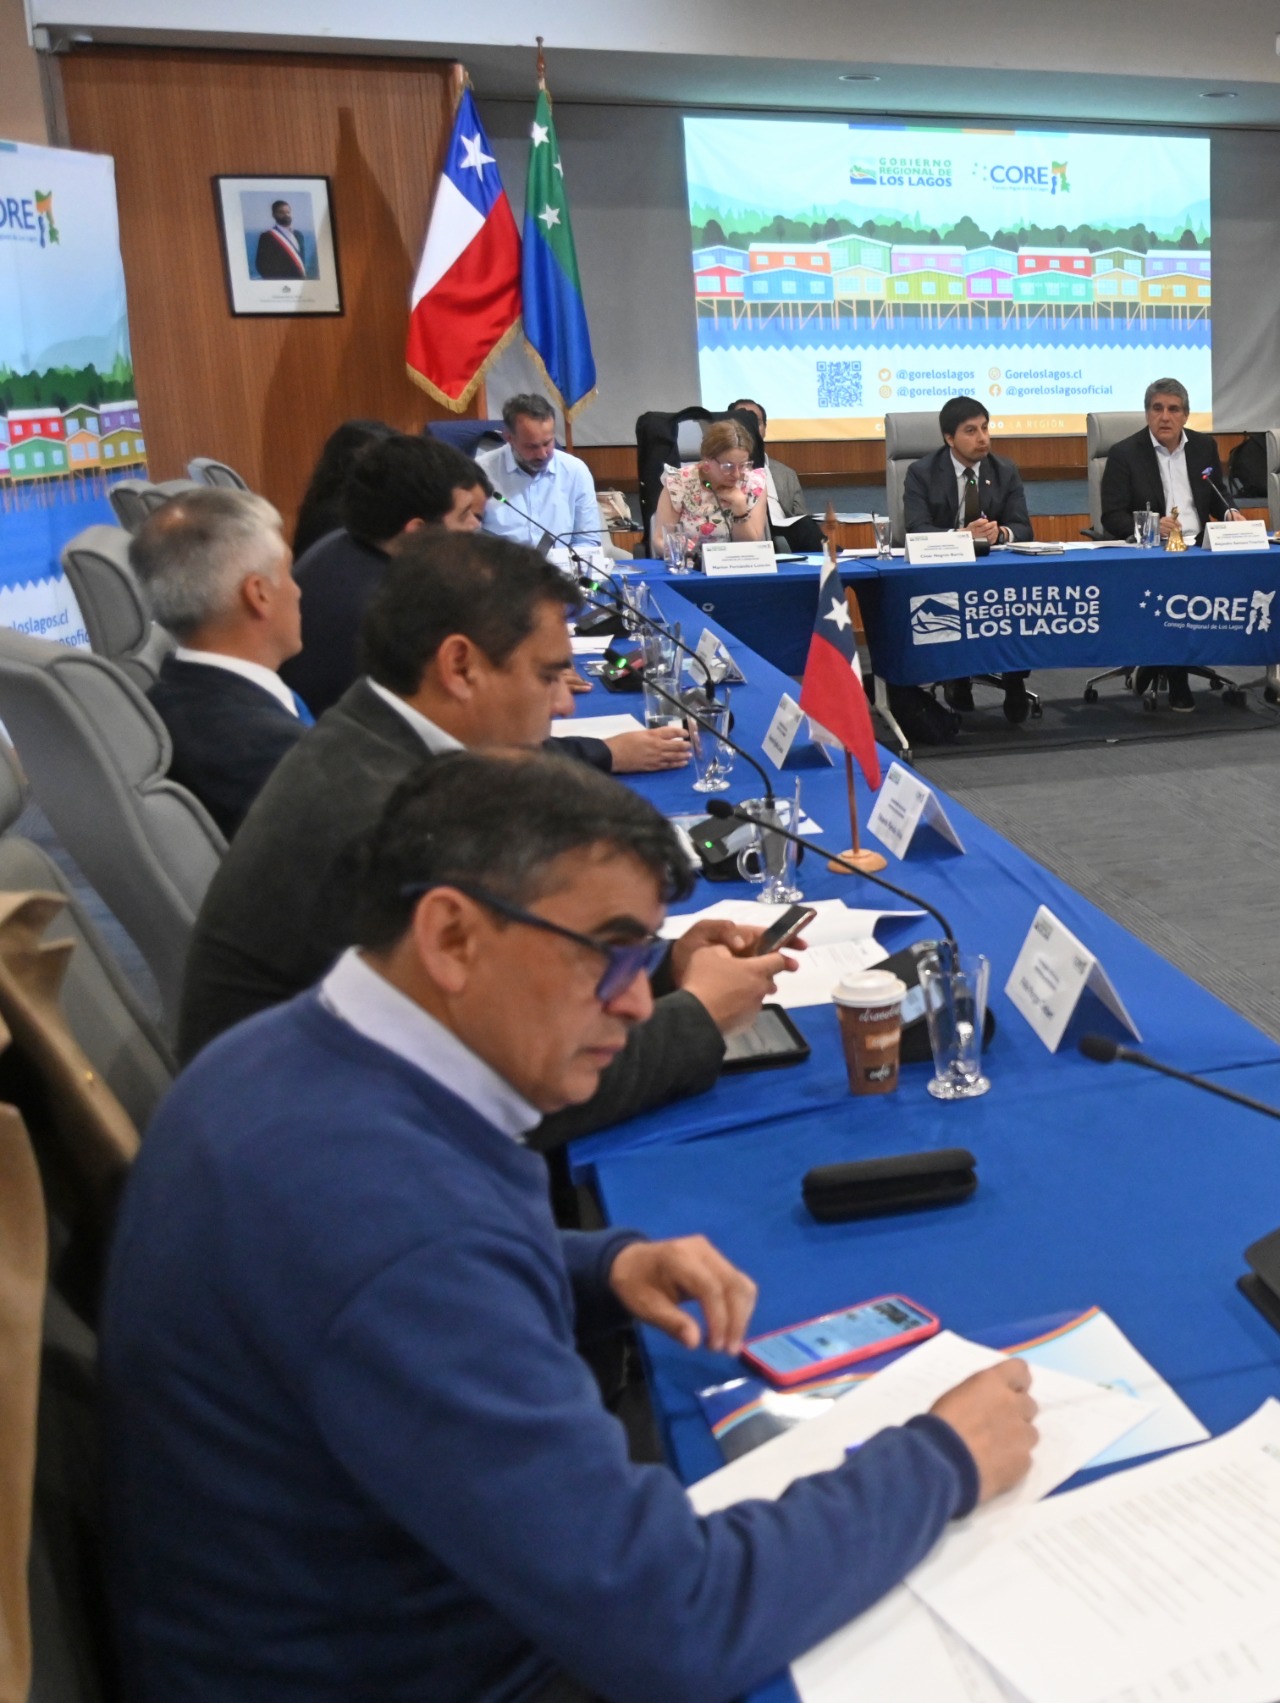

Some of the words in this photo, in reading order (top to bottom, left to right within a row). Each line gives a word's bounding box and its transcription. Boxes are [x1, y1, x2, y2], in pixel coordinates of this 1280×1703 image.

[879, 157, 952, 168] GOBIERNO
[879, 166, 935, 176] REGIONAL
[938, 168, 952, 177] DE
[990, 165, 1048, 185] CORE
[880, 175, 904, 186] LOS
[908, 176, 952, 187] LAGOS
[896, 369, 975, 381] @goreloslagos
[1005, 368, 1083, 381] Goreloslagos.cl
[897, 386, 976, 398] @goreloslagos
[1006, 384, 1113, 397] @goreloslagosoficial
[964, 586, 1100, 604] GOBIERNO
[965, 602, 1068, 620] REGIONAL
[1075, 601, 1099, 615] DE
[1166, 594, 1248, 621] CORE
[966, 619, 1012, 639] LOS
[1020, 617, 1099, 635] LAGOS
[1164, 621, 1185, 629] Consejo
